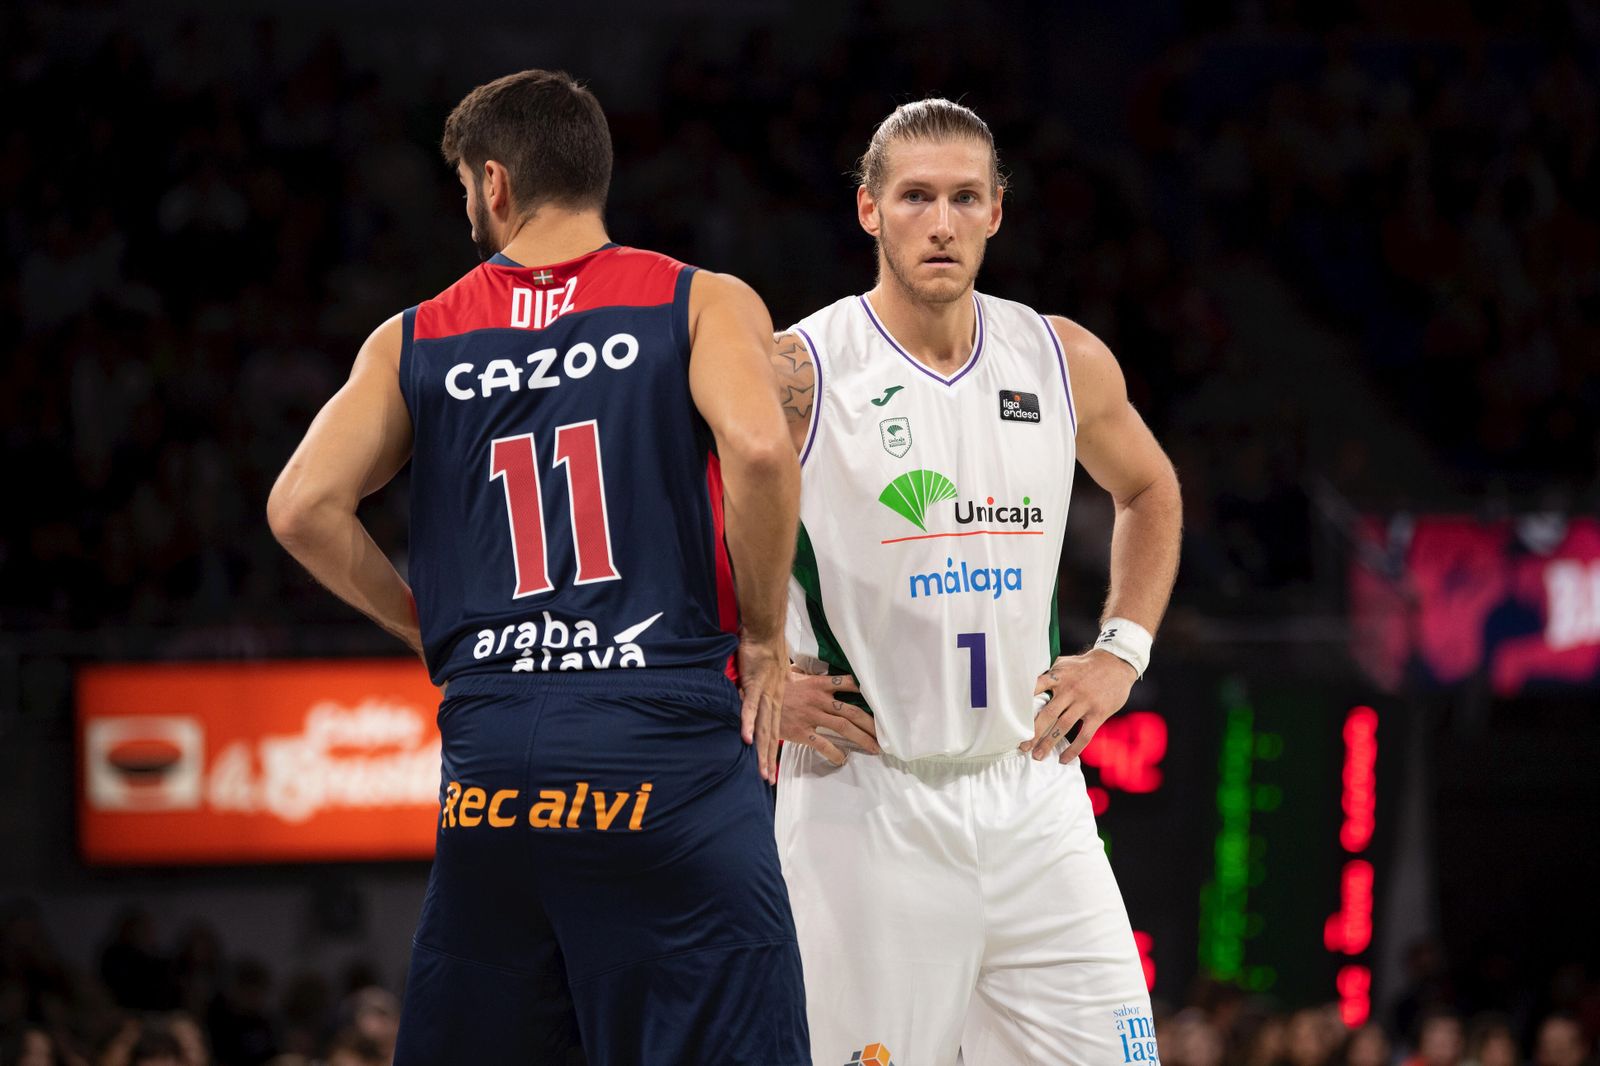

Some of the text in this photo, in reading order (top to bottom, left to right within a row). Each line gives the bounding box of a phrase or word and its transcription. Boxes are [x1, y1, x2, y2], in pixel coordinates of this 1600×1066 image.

[510, 276, 578, 329] DIEZ
[445, 333, 639, 401] CAZOO
[1003, 398, 1020, 410] liga
[1003, 409, 1039, 420] endesa
[489, 419, 622, 600] 11
[955, 496, 1044, 530] Unicaja
[909, 557, 1023, 599] málaga
[473, 611, 598, 660] araba
[957, 632, 988, 709] 1
[1113, 1003, 1141, 1017] sabor
[1116, 1019, 1125, 1031] a
